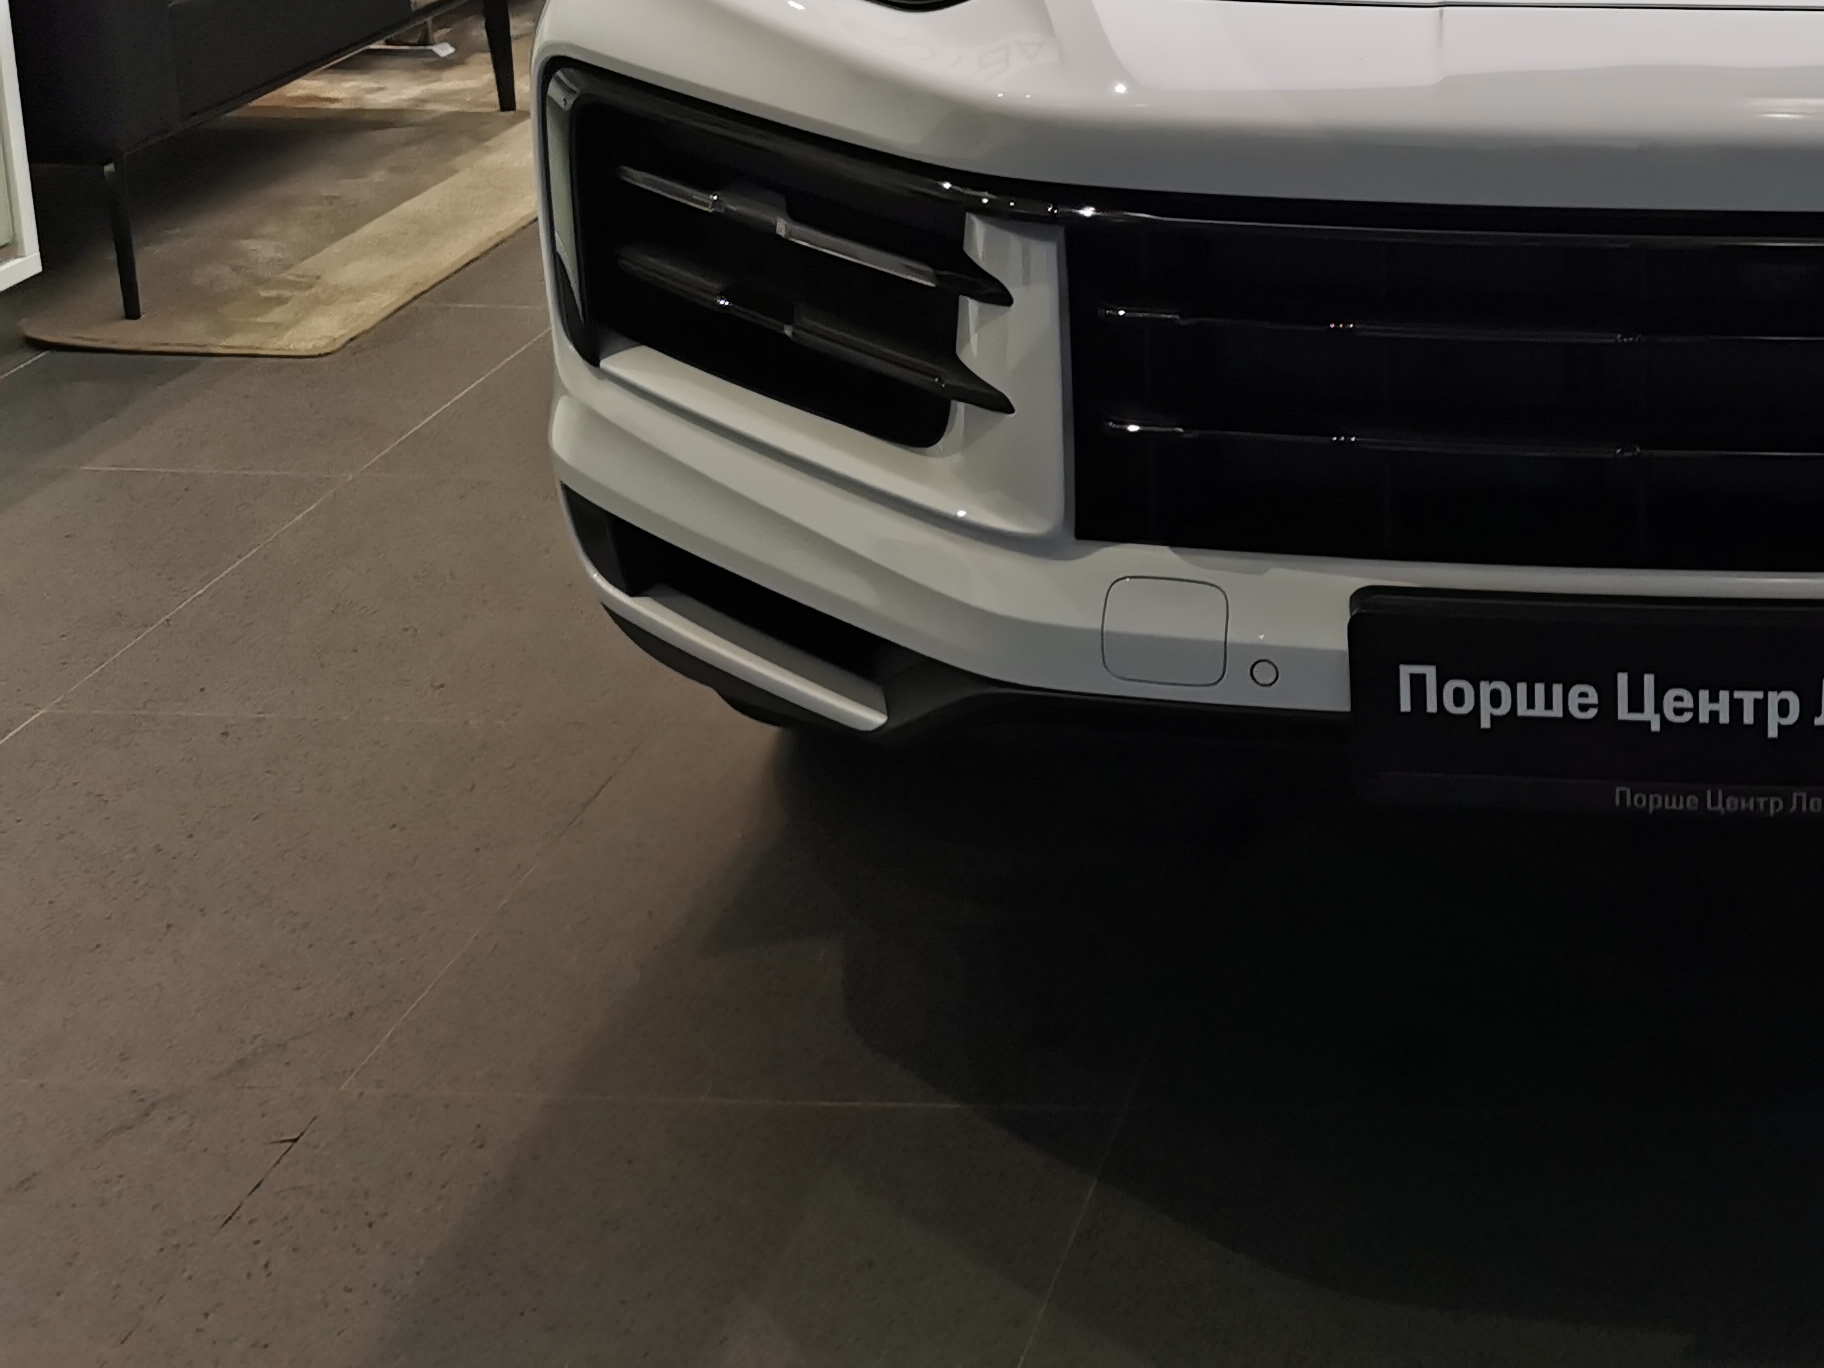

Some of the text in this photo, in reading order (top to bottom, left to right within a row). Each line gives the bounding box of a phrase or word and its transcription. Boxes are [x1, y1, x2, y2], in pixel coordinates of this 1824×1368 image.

[1399, 664, 1600, 729] Порше
[1616, 672, 1801, 739] Центр
[1614, 786, 1699, 814] Порше
[1706, 789, 1784, 818] Центр
